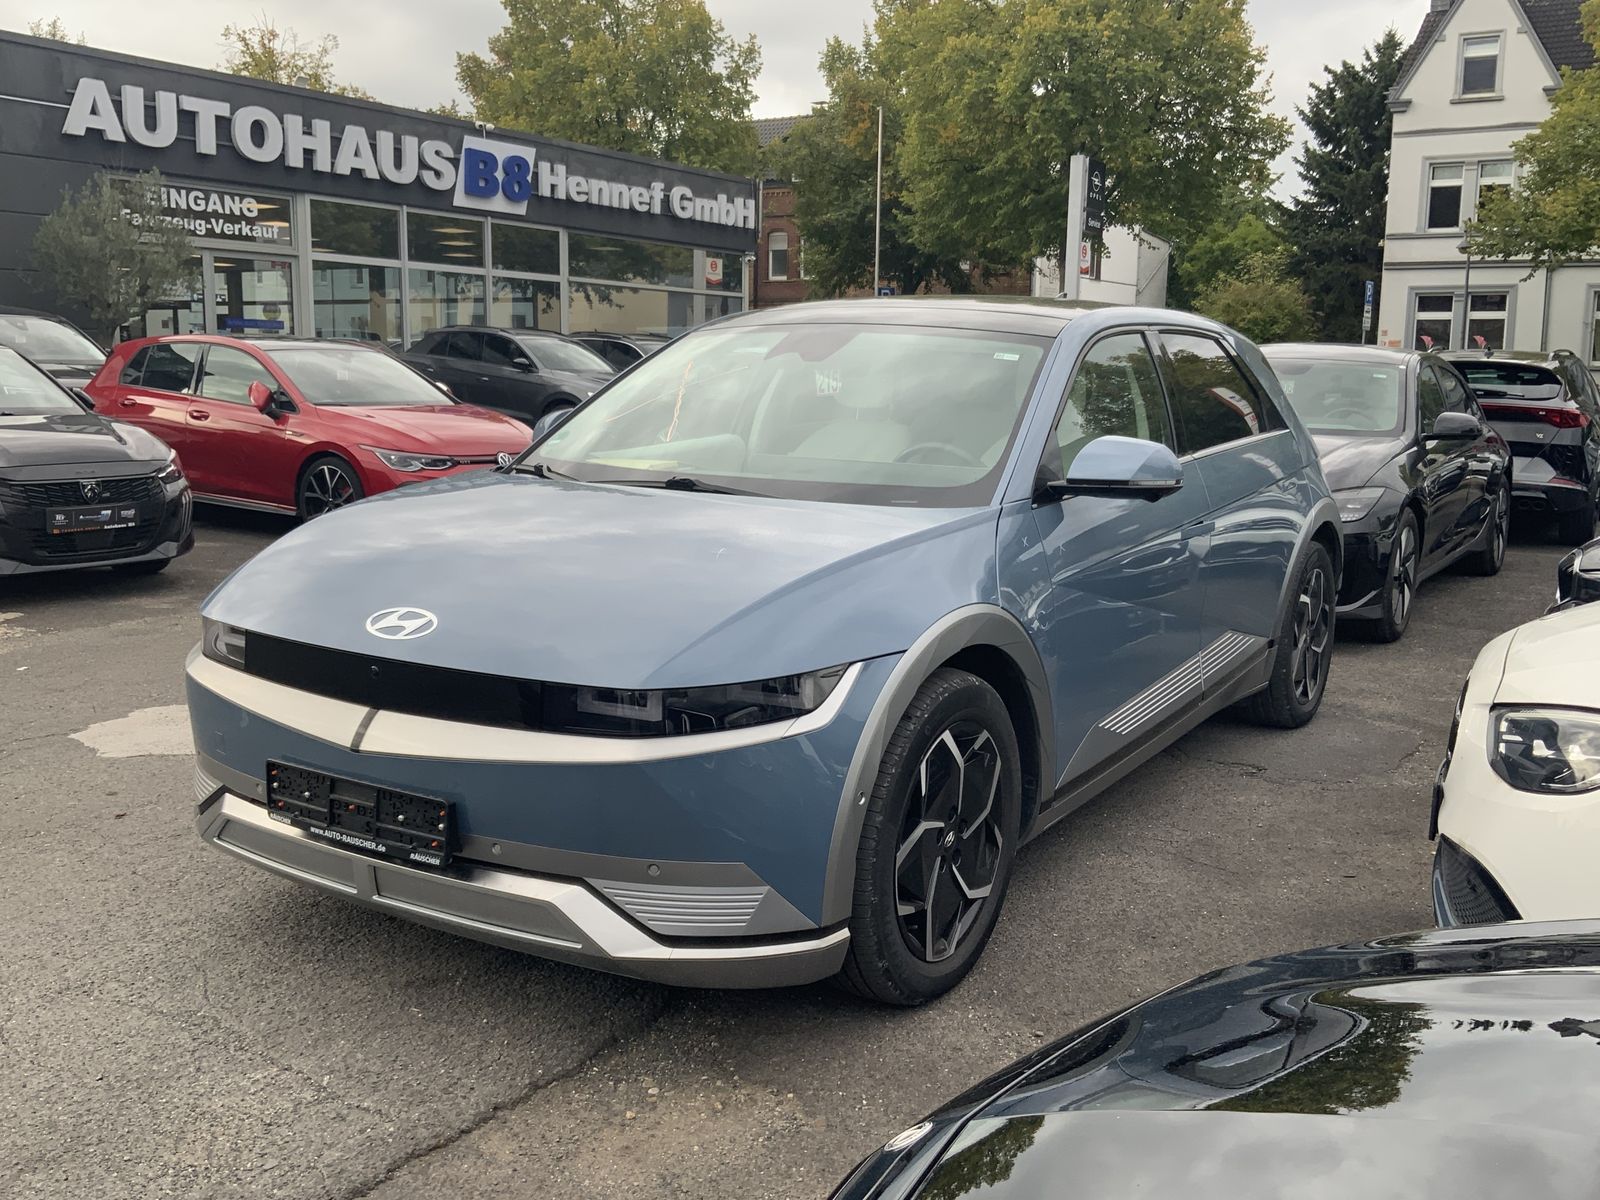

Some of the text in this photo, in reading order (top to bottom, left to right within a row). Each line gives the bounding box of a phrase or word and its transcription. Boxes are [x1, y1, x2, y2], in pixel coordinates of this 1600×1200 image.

[62, 77, 756, 229] AUTOHAUS B8 Hennef GmbH
[120, 208, 279, 239] Fazeug-Verkauf
